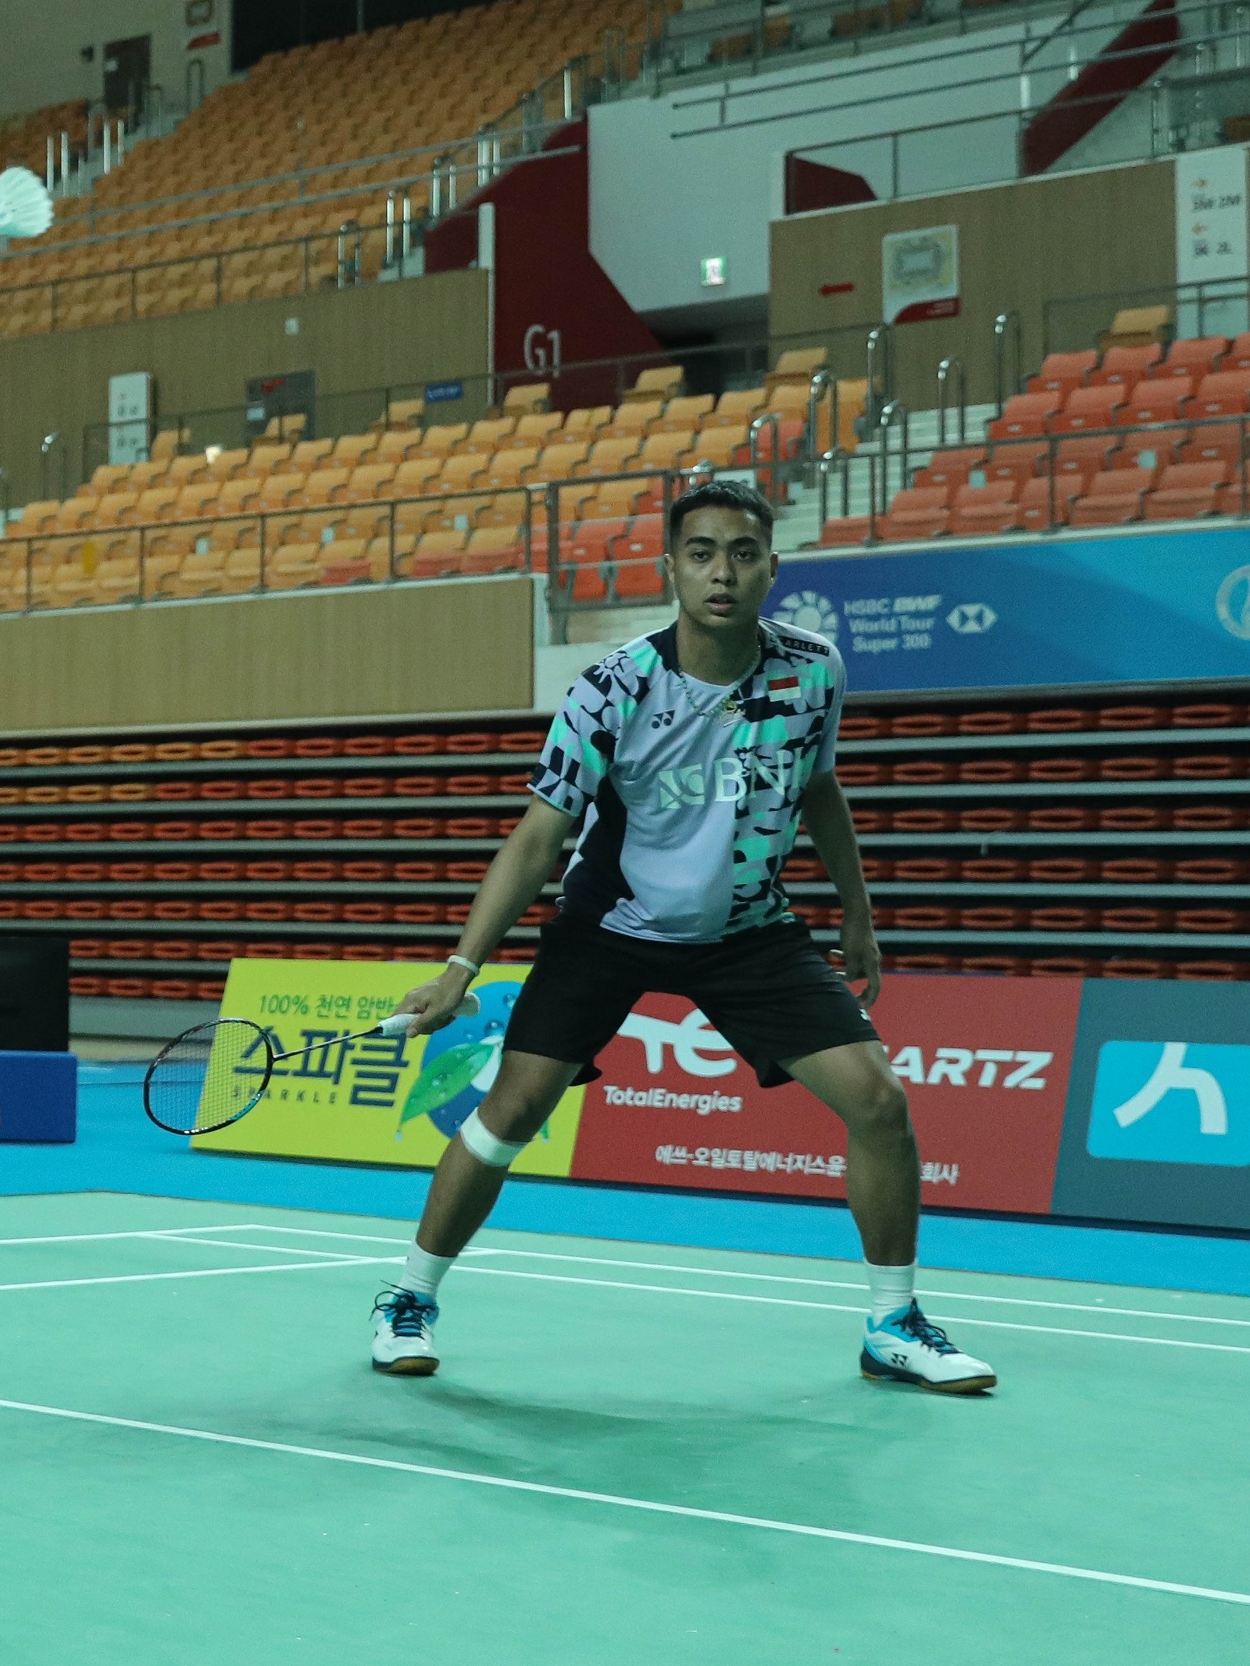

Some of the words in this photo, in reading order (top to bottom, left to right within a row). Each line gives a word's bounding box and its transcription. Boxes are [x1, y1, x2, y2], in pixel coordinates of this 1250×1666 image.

[524, 323, 560, 378] G1
[849, 615, 898, 634] World
[899, 614, 935, 632] Tour
[852, 636, 898, 654] Super
[260, 994, 310, 1016] 100%
[316, 994, 350, 1018] 천연
[357, 996, 397, 1020] 암반
[232, 1025, 410, 1108] 스파클
[884, 1045, 1054, 1090] ARTZ
[603, 1085, 743, 1116] TotalEnergies
